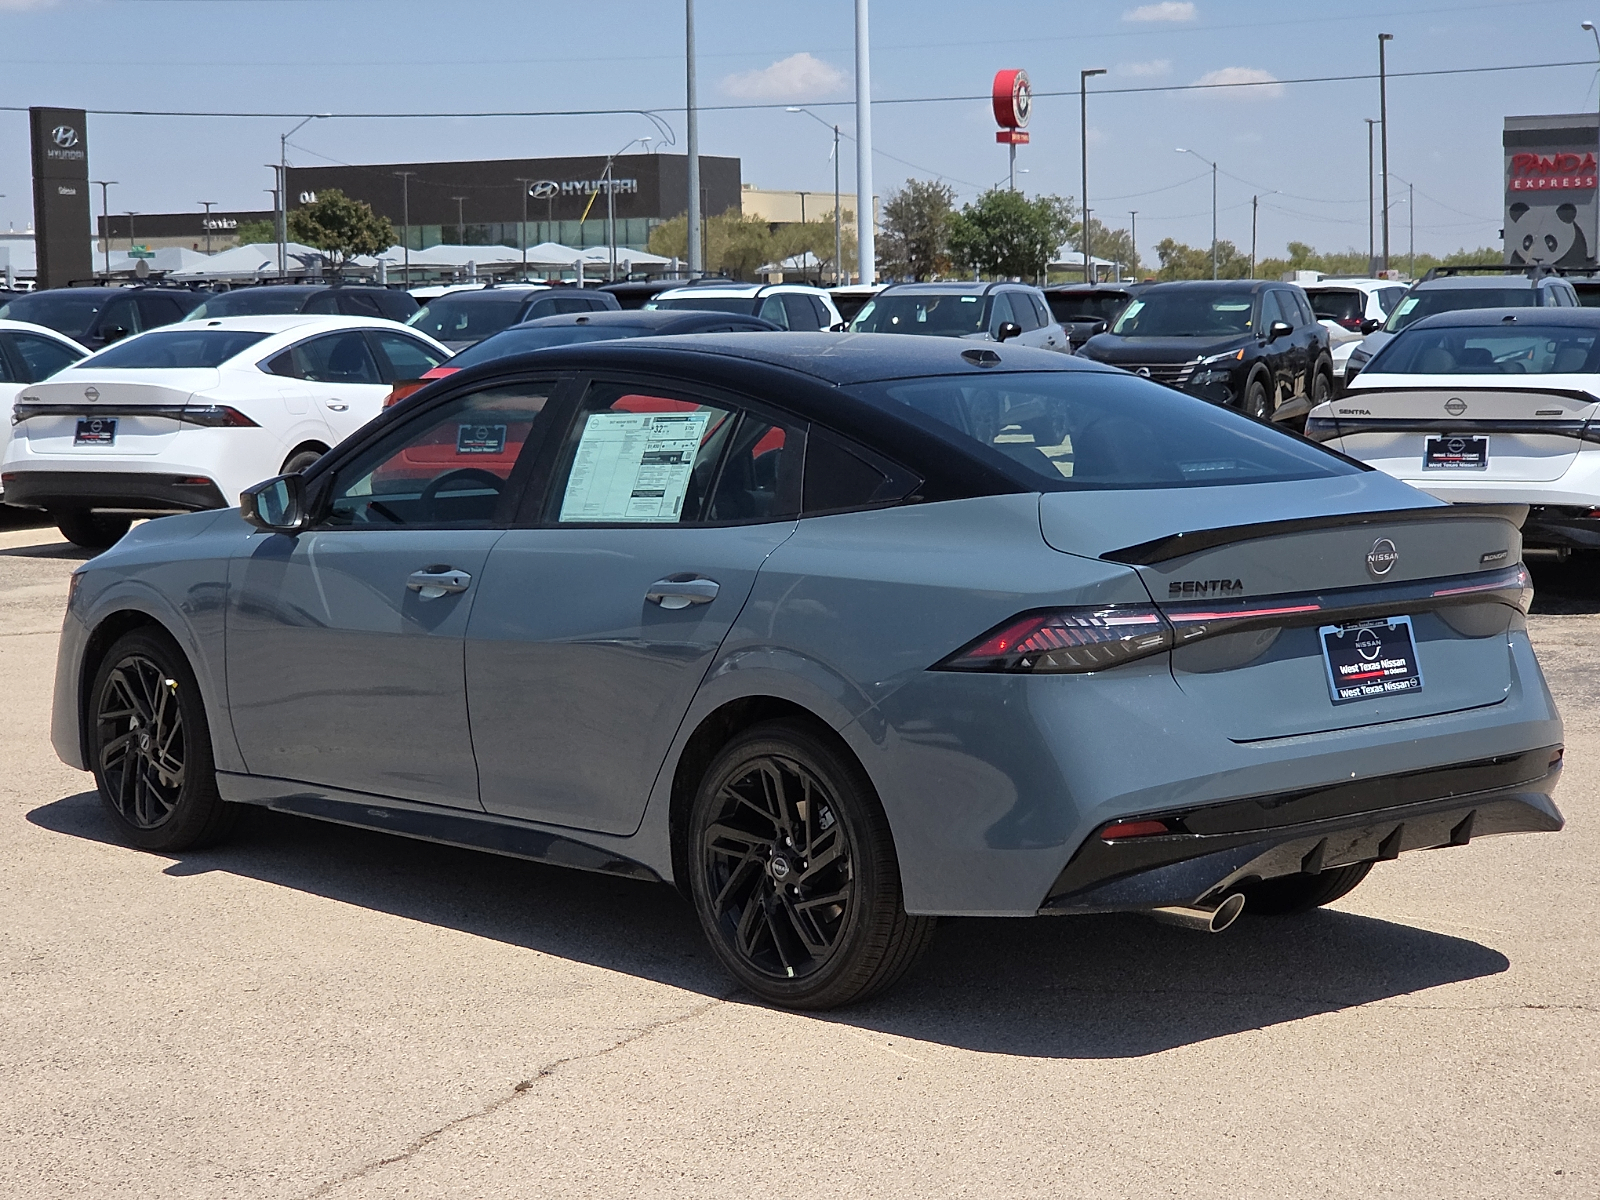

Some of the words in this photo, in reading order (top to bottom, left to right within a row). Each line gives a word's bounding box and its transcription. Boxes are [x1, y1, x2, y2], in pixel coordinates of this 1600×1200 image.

[47, 149, 84, 160] HYUNDAI
[1512, 152, 1597, 176] PANDA
[562, 179, 638, 196] HYUNDAI
[1514, 177, 1594, 189] EXPRESS
[202, 217, 238, 230] Service
[1338, 408, 1372, 416] SENTRA
[1367, 553, 1399, 562] NISSAN
[1169, 578, 1243, 593] SENTRA
[1355, 640, 1382, 648] NISSAN
[1340, 664, 1360, 675] West
[1359, 661, 1381, 672] Texas
[1380, 658, 1406, 669] Nissan
[1340, 687, 1362, 699] West
[1361, 684, 1384, 695] Texas
[1384, 680, 1411, 692] Nissan
